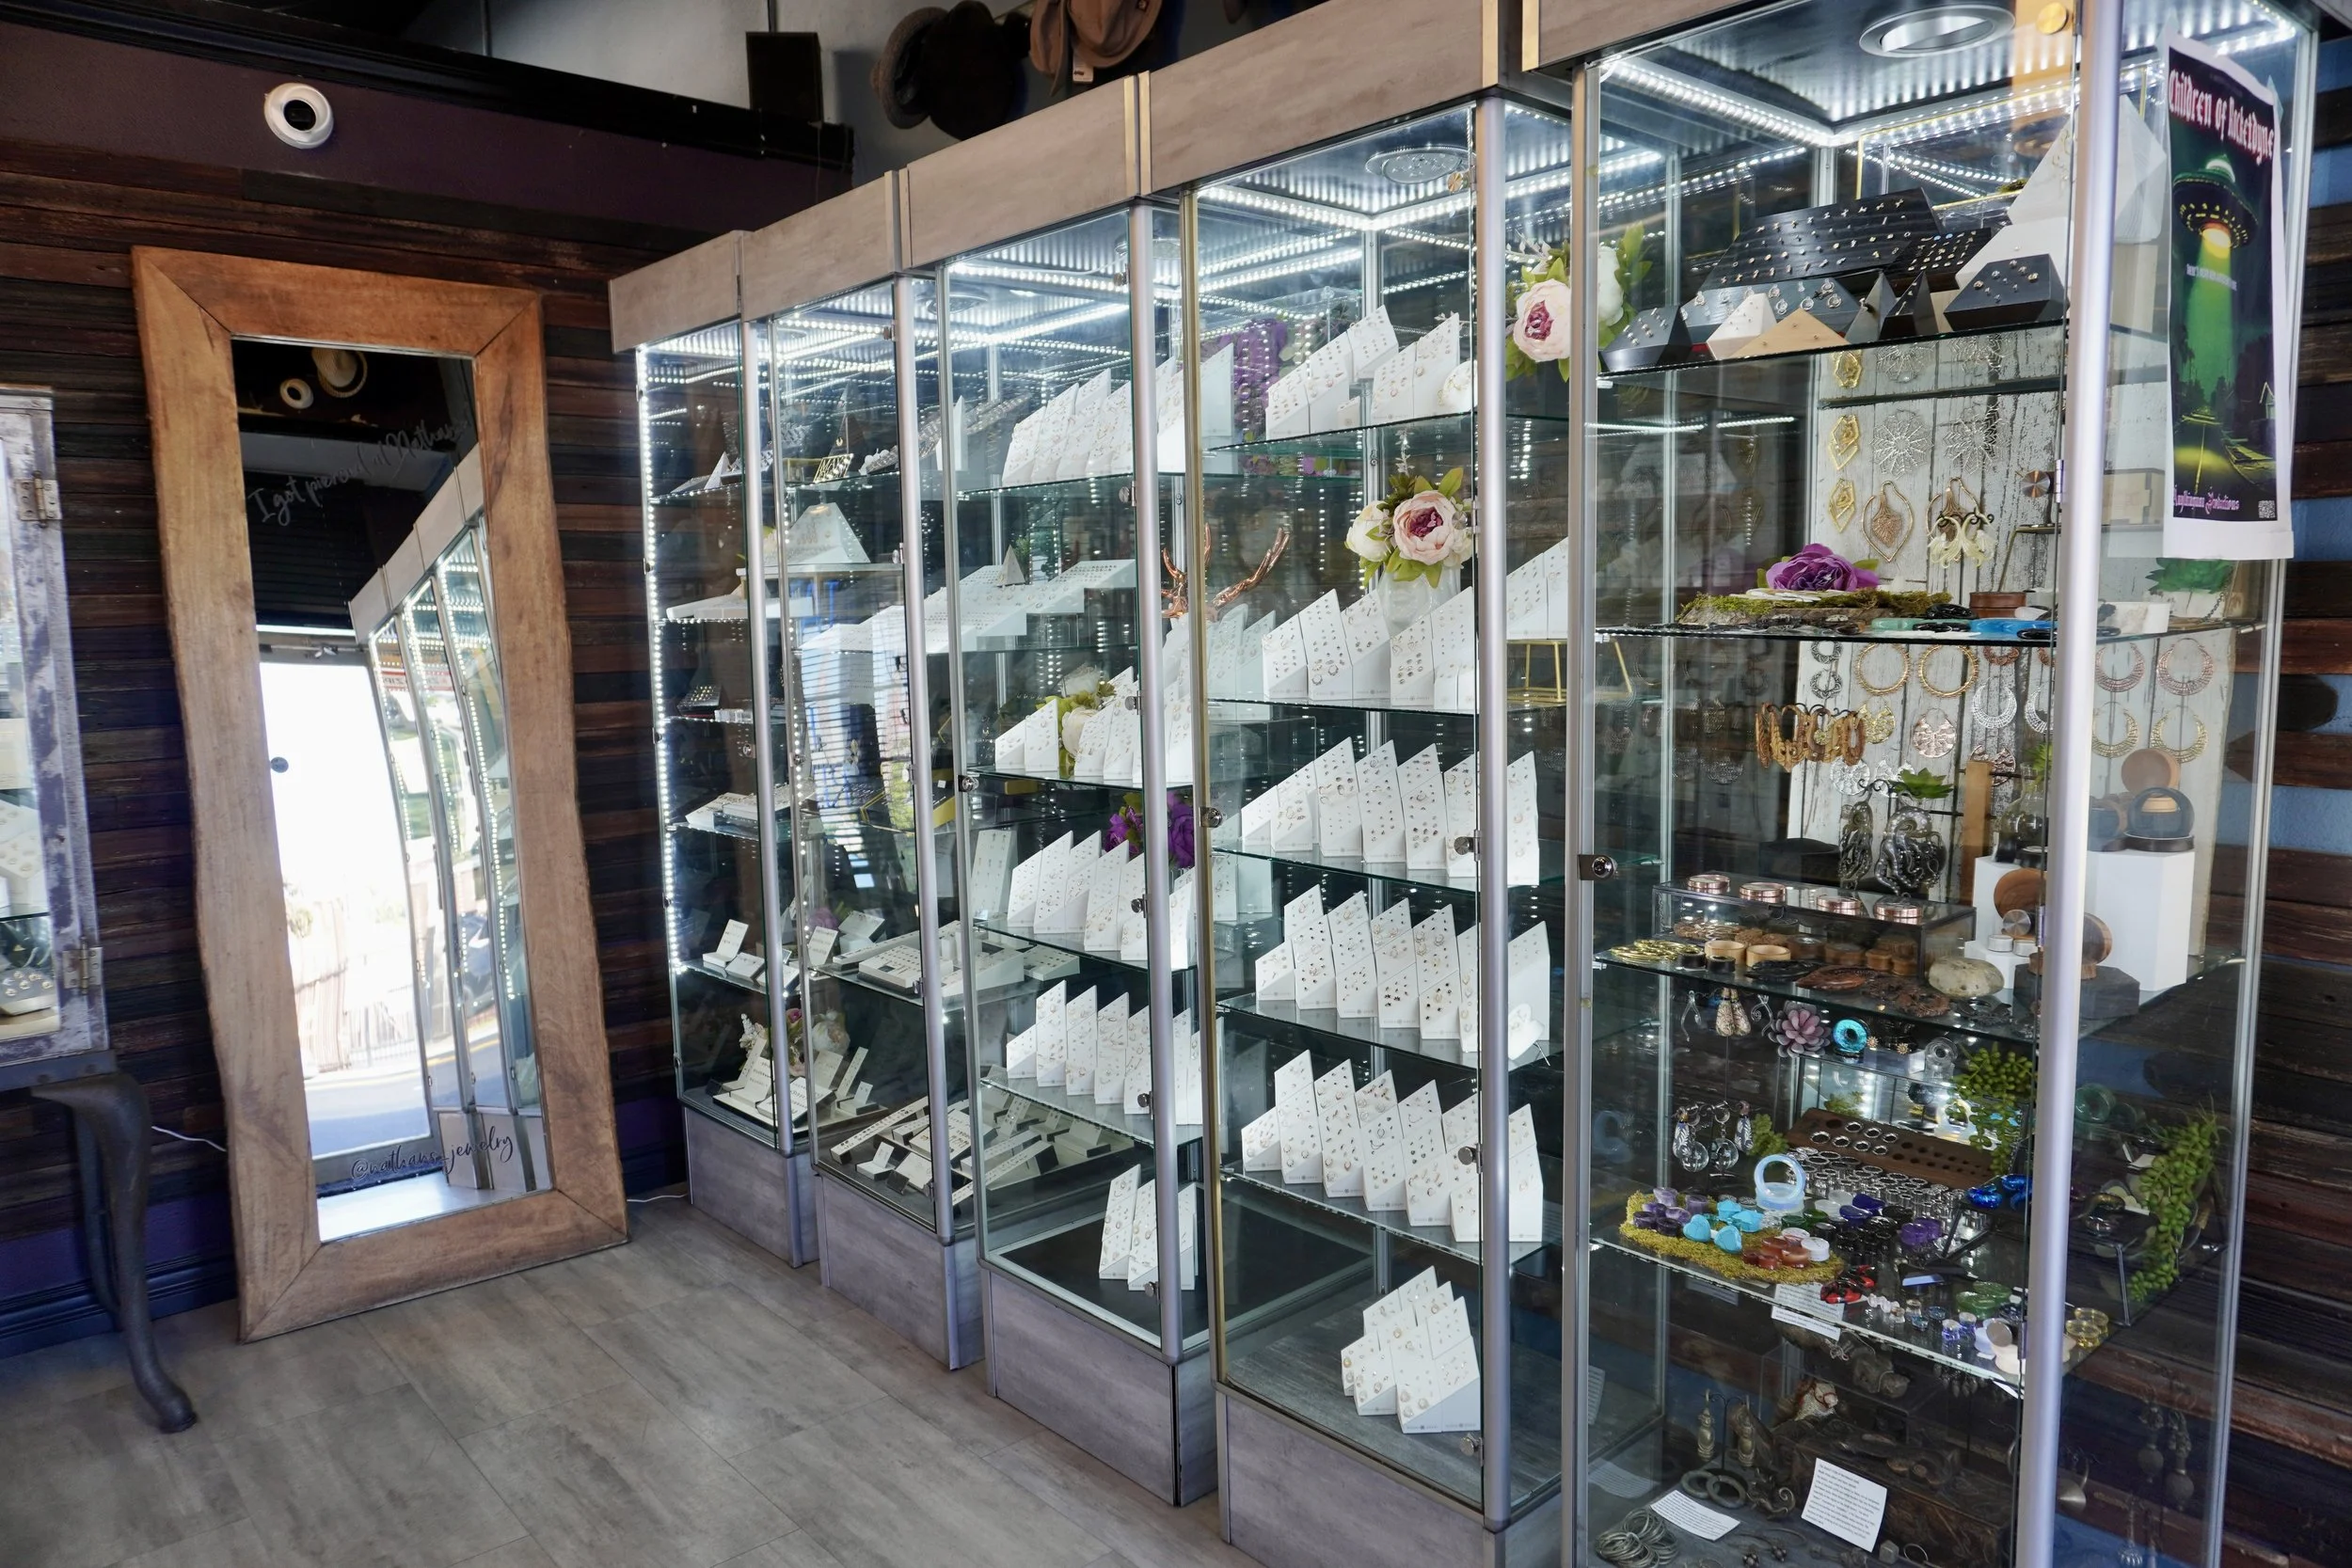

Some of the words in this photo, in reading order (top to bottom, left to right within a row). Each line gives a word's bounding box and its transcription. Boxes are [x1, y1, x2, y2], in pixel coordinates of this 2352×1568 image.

[2169, 69, 2213, 129] Children
[2215, 97, 2228, 141] of
[2228, 96, 2275, 166] Rocketdyne
[247, 487, 278, 523] I
[273, 475, 306, 527] got
